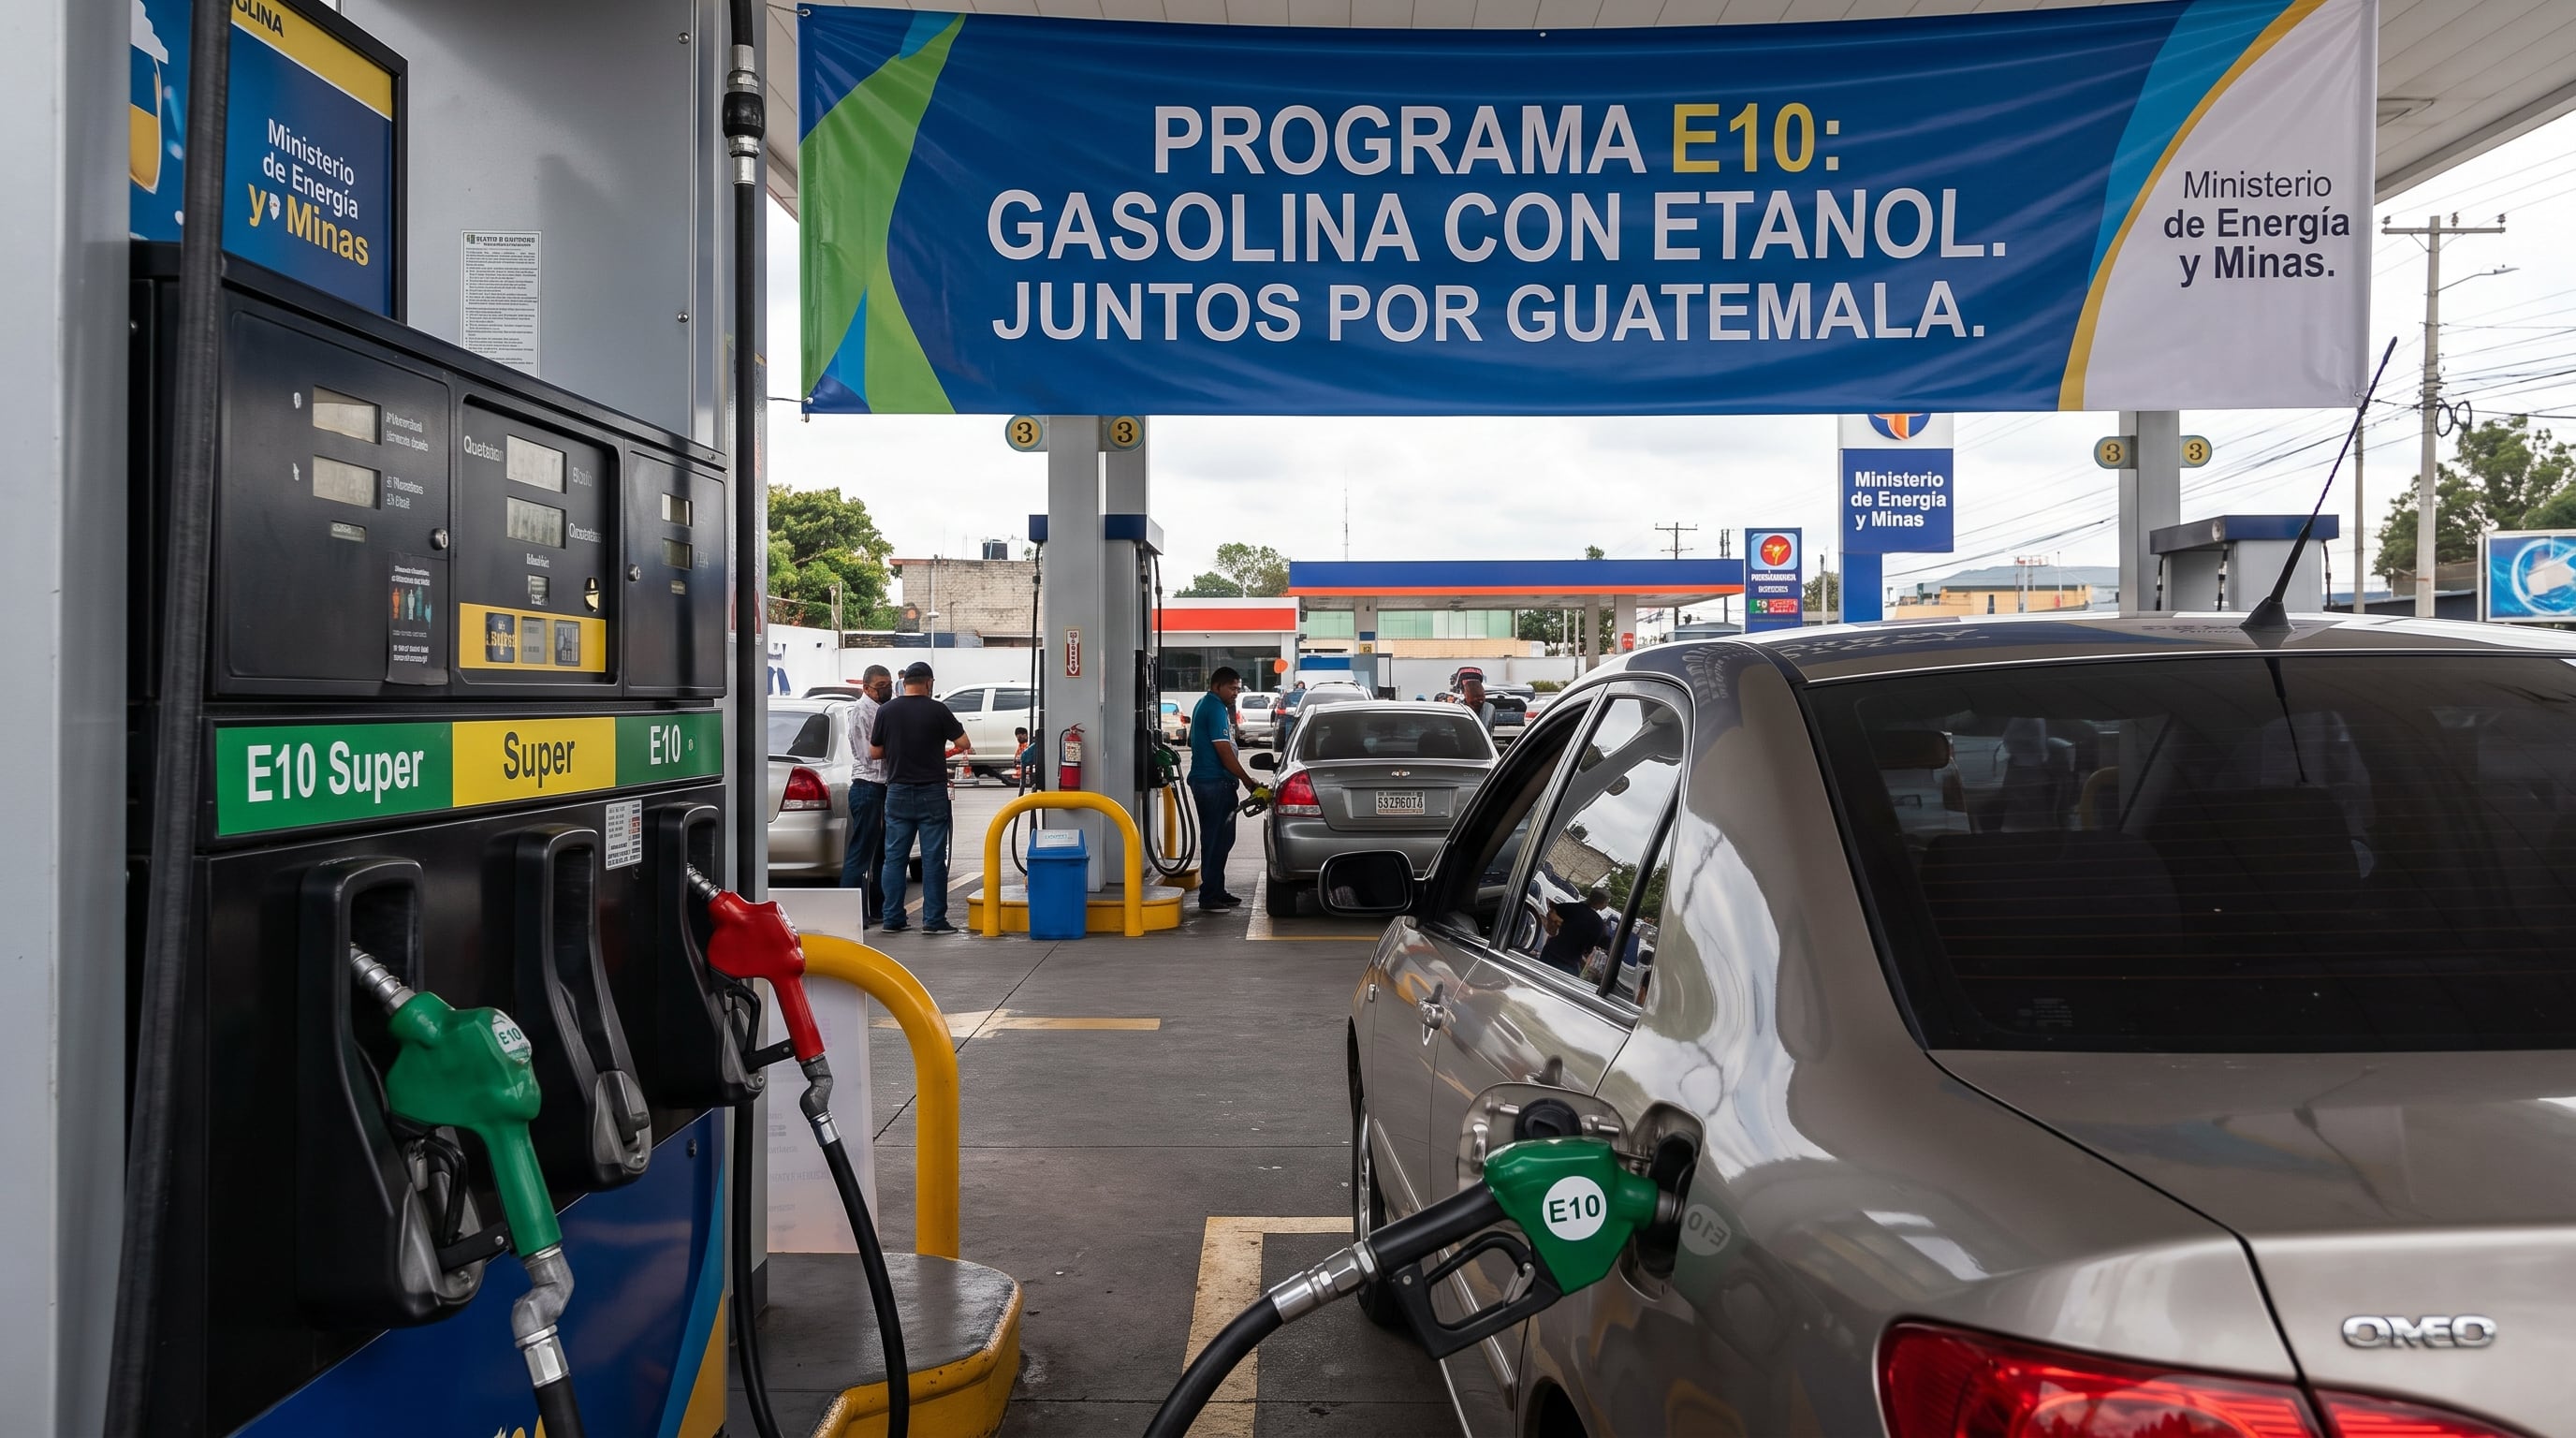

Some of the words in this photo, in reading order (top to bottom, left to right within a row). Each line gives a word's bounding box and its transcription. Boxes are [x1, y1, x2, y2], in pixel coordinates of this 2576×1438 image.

[268, 118, 355, 186] Ministerio
[1155, 104, 1647, 176] PROGRAMA
[1673, 103, 1839, 173] E10:
[263, 152, 286, 183] de
[292, 163, 359, 220] Energía
[2184, 169, 2332, 198] Ministerio
[248, 183, 268, 227] y
[287, 194, 370, 266] Minas
[988, 189, 1420, 263] GASOLINA
[1444, 192, 1620, 263] CON
[1654, 187, 2006, 261] ETANOL.
[2163, 209, 2205, 239] de
[2217, 205, 2350, 245] Energía
[2178, 255, 2202, 288] y
[2215, 245, 2334, 279] Minas.
[992, 281, 1301, 343] JUNTOS
[1329, 285, 1483, 344] POR
[1506, 280, 1984, 343] GUATEMALA.
[1017, 421, 1032, 443] 3
[1117, 421, 1133, 443] 3
[2188, 442, 2203, 460] 3
[2106, 443, 2121, 462] 3
[1851, 491, 1873, 507] de
[1855, 471, 1944, 488] Ministerio
[1855, 515, 1866, 530] y
[1872, 510, 1925, 527] Minas
[503, 731, 576, 788] Super
[650, 724, 681, 766] E10
[247, 742, 316, 802] E10
[329, 741, 424, 804] Super
[498, 1027, 522, 1045] E10
[1548, 1194, 1601, 1224] E10
